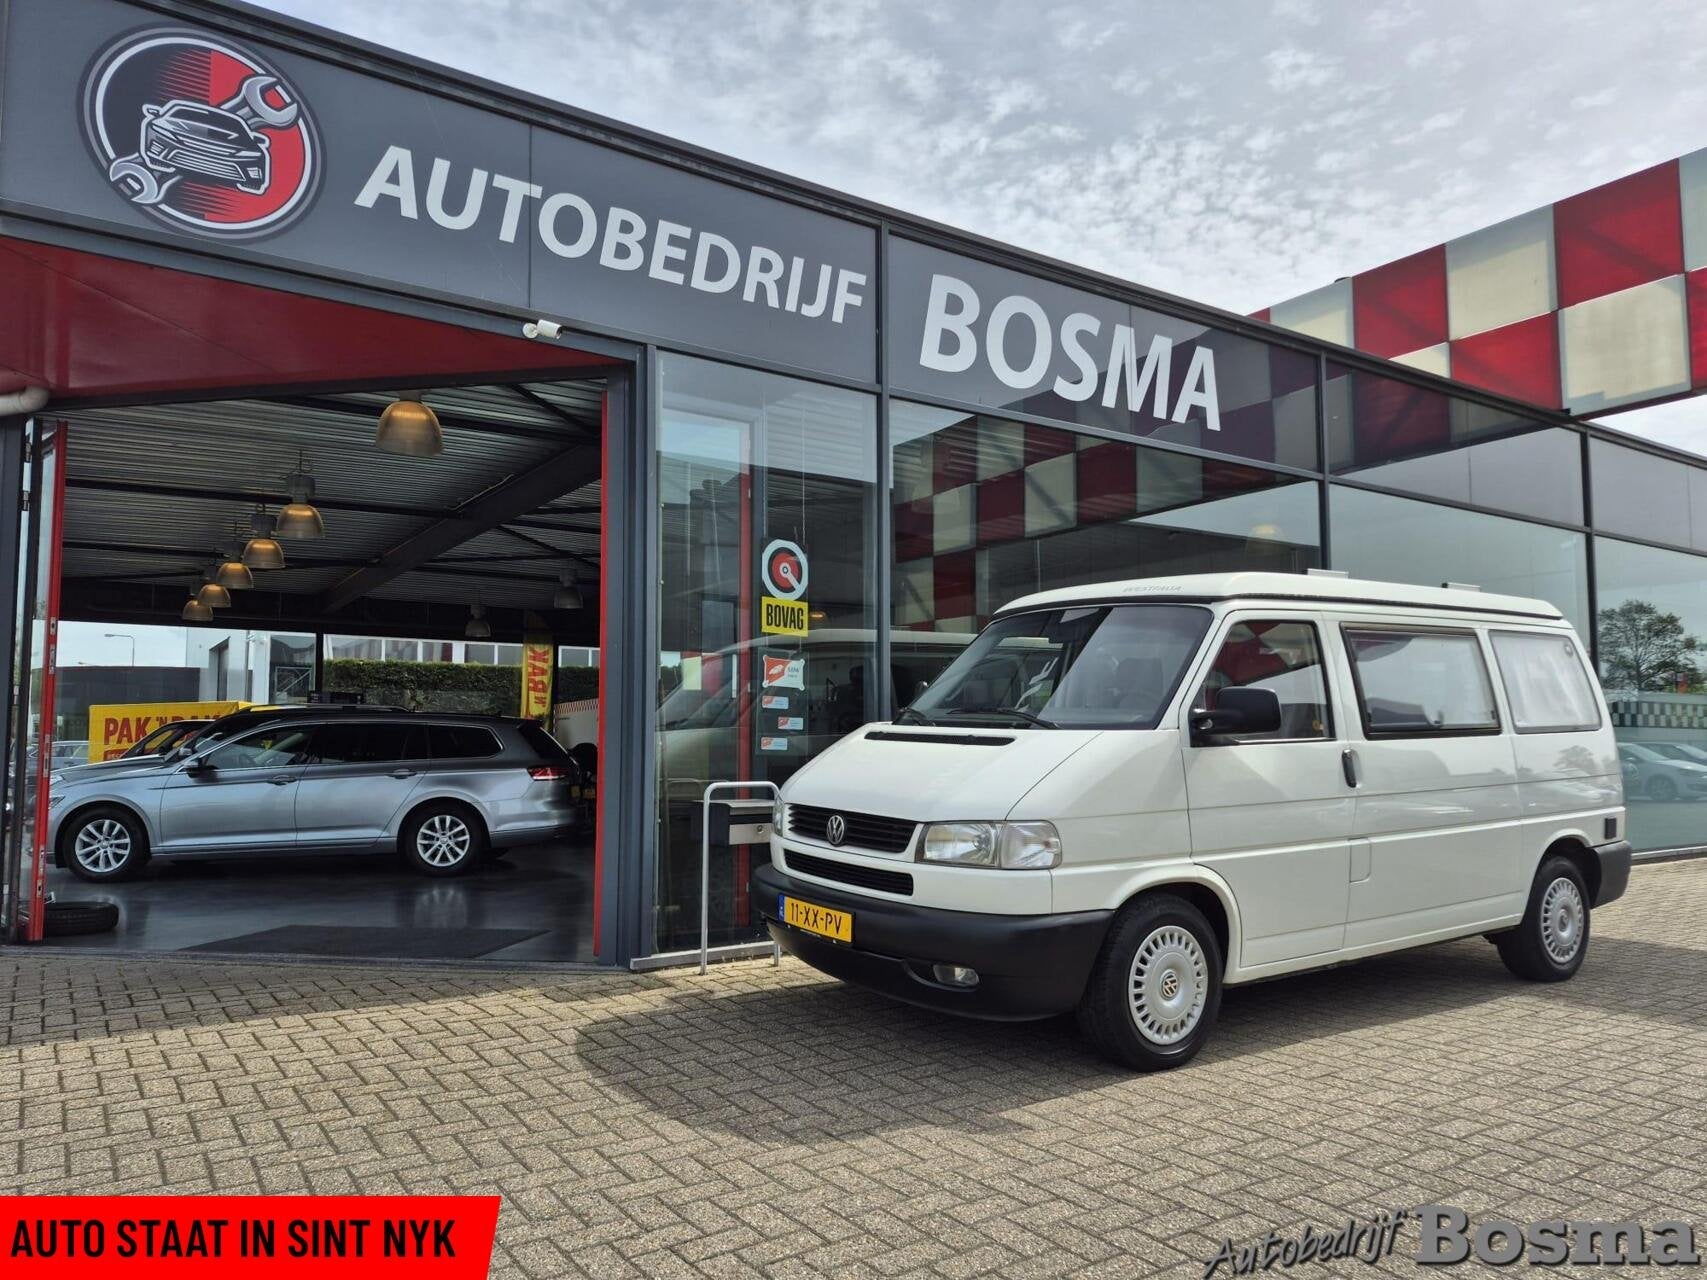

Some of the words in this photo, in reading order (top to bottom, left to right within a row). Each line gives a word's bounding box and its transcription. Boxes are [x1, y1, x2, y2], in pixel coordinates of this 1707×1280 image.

[354, 145, 867, 324] AUTOBEDRIJF
[919, 274, 1221, 431] BOSMA
[766, 603, 804, 630] BOVAG
[104, 716, 152, 745] PAK
[791, 902, 842, 935] 11-XX-PV
